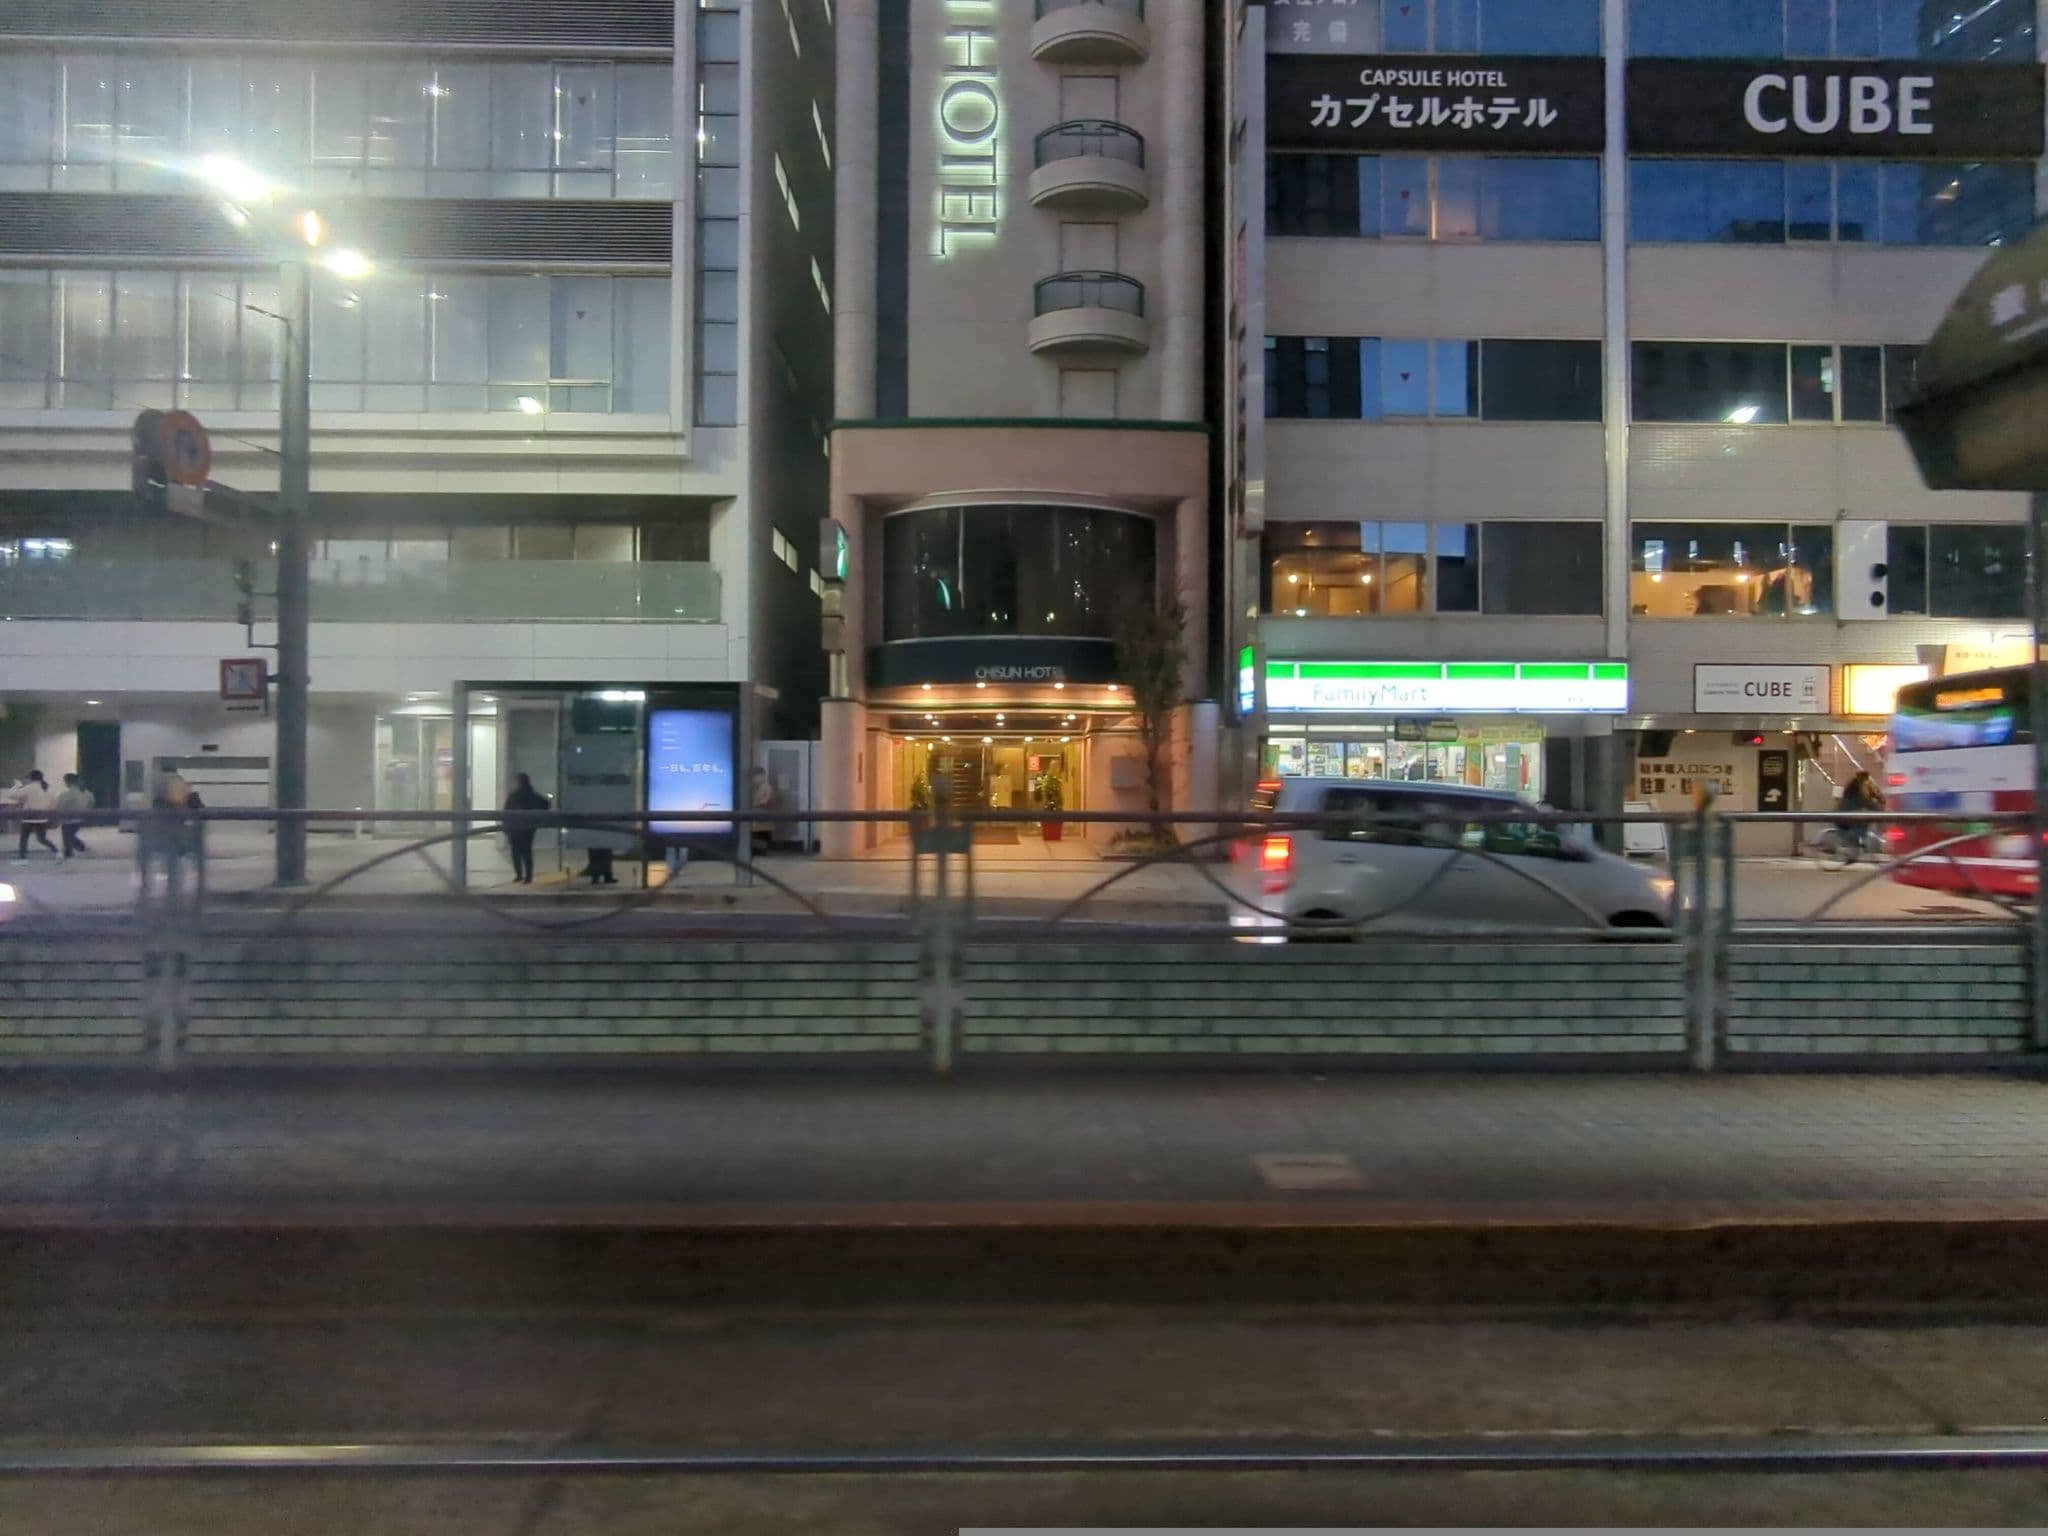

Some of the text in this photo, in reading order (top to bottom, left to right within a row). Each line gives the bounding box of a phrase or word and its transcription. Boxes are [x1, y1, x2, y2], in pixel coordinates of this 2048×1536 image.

[1360, 69, 1507, 89] CAPSULE HOTEL
[1309, 94, 1558, 130] カプセルホテル
[1743, 74, 1935, 136] CUBE
[941, 25, 998, 256] HOTEL
[1024, 666, 1063, 680] HOT
[1312, 684, 1429, 709] FamilyMart
[1744, 682, 1792, 697] CUBE
